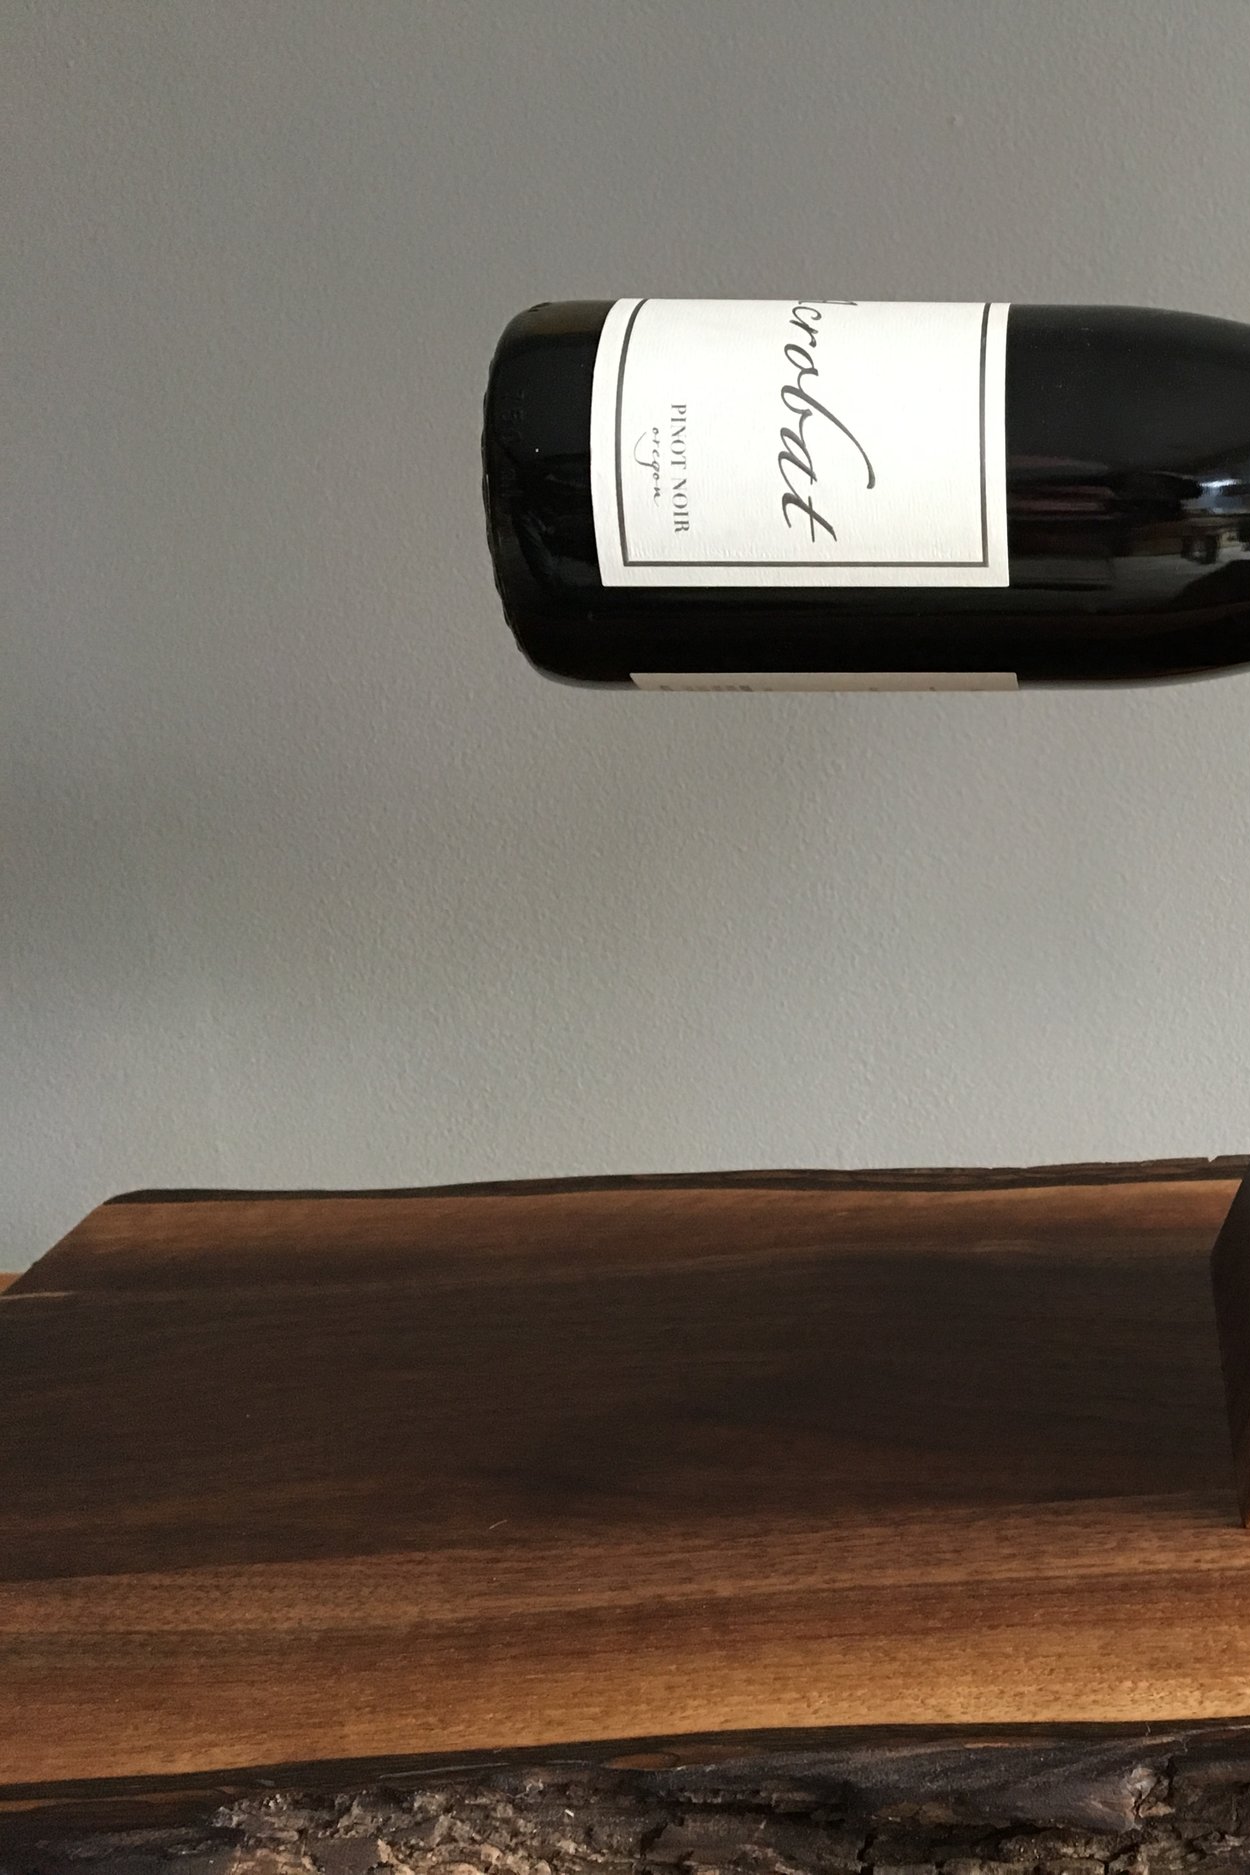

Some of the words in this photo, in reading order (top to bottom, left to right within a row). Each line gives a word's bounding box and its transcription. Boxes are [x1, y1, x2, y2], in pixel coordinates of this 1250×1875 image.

[634, 427, 661, 507] oregon
[671, 404, 688, 470] PINOT
[673, 477, 690, 533] NOIR
